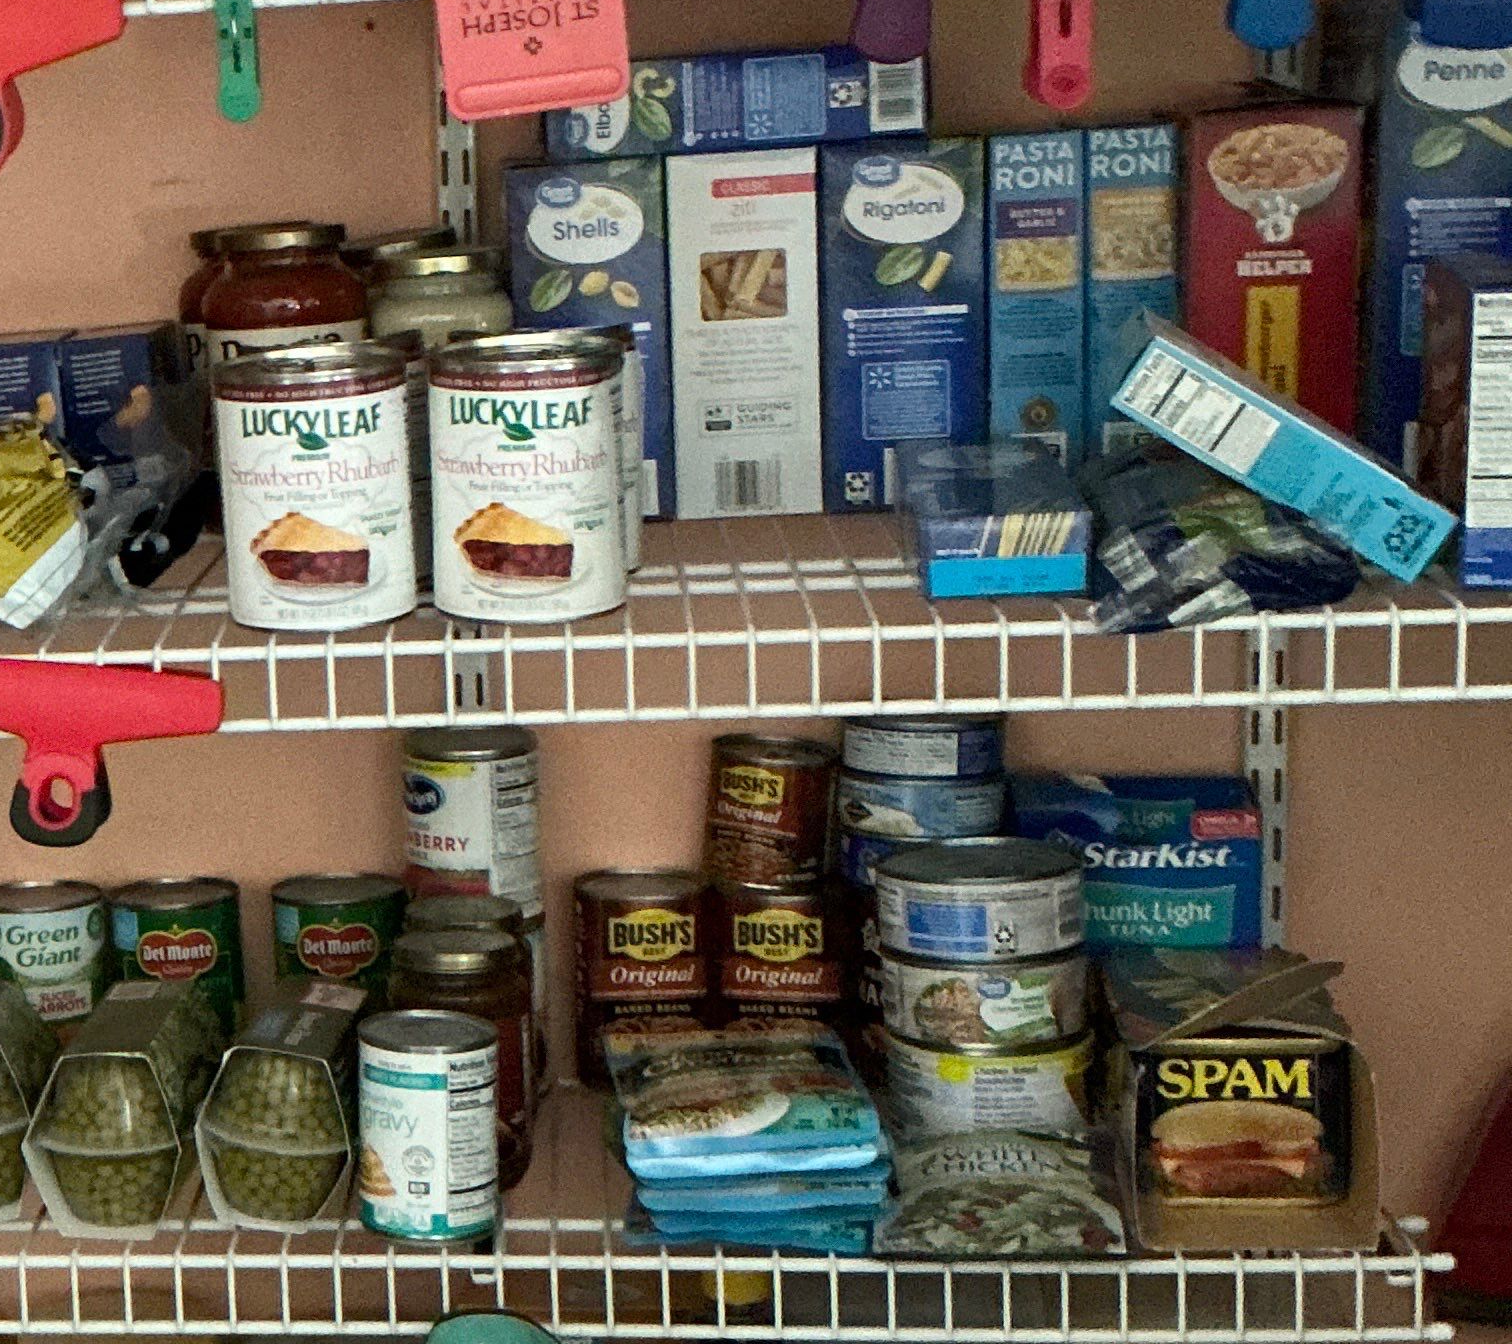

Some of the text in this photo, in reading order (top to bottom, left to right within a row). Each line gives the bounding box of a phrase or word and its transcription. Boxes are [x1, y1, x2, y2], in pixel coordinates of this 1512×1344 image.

[461, 1, 562, 39] JOSEPH
[1423, 60, 1506, 82] Penne
[995, 138, 1075, 164] PASTA
[1089, 126, 1171, 151] PASTA
[995, 164, 1076, 191] RONI
[1091, 152, 1173, 179] RONI
[863, 196, 945, 220] Rigatoni
[553, 217, 619, 241] Shells
[241, 402, 381, 439] LUCKY LEAF
[450, 394, 593, 430] LUCKY LEAF
[230, 455, 401, 492] Strawberry Rhubarb
[437, 455, 530, 482] Strawberry
[722, 769, 779, 798] BUSH'S
[1084, 842, 1232, 869] StarKist
[1154, 902, 1213, 928] Light
[6, 925, 80, 948] Green
[613, 918, 693, 948] BUSH'S
[736, 919, 820, 948] BUSH'S
[1110, 923, 1171, 936] TUNA
[16, 945, 81, 969] Giant
[142, 941, 215, 962] Del Monte
[302, 937, 376, 956] Del Monte
[609, 964, 694, 988] Original
[735, 964, 823, 988] Original
[1156, 1058, 1312, 1100] SPAM
